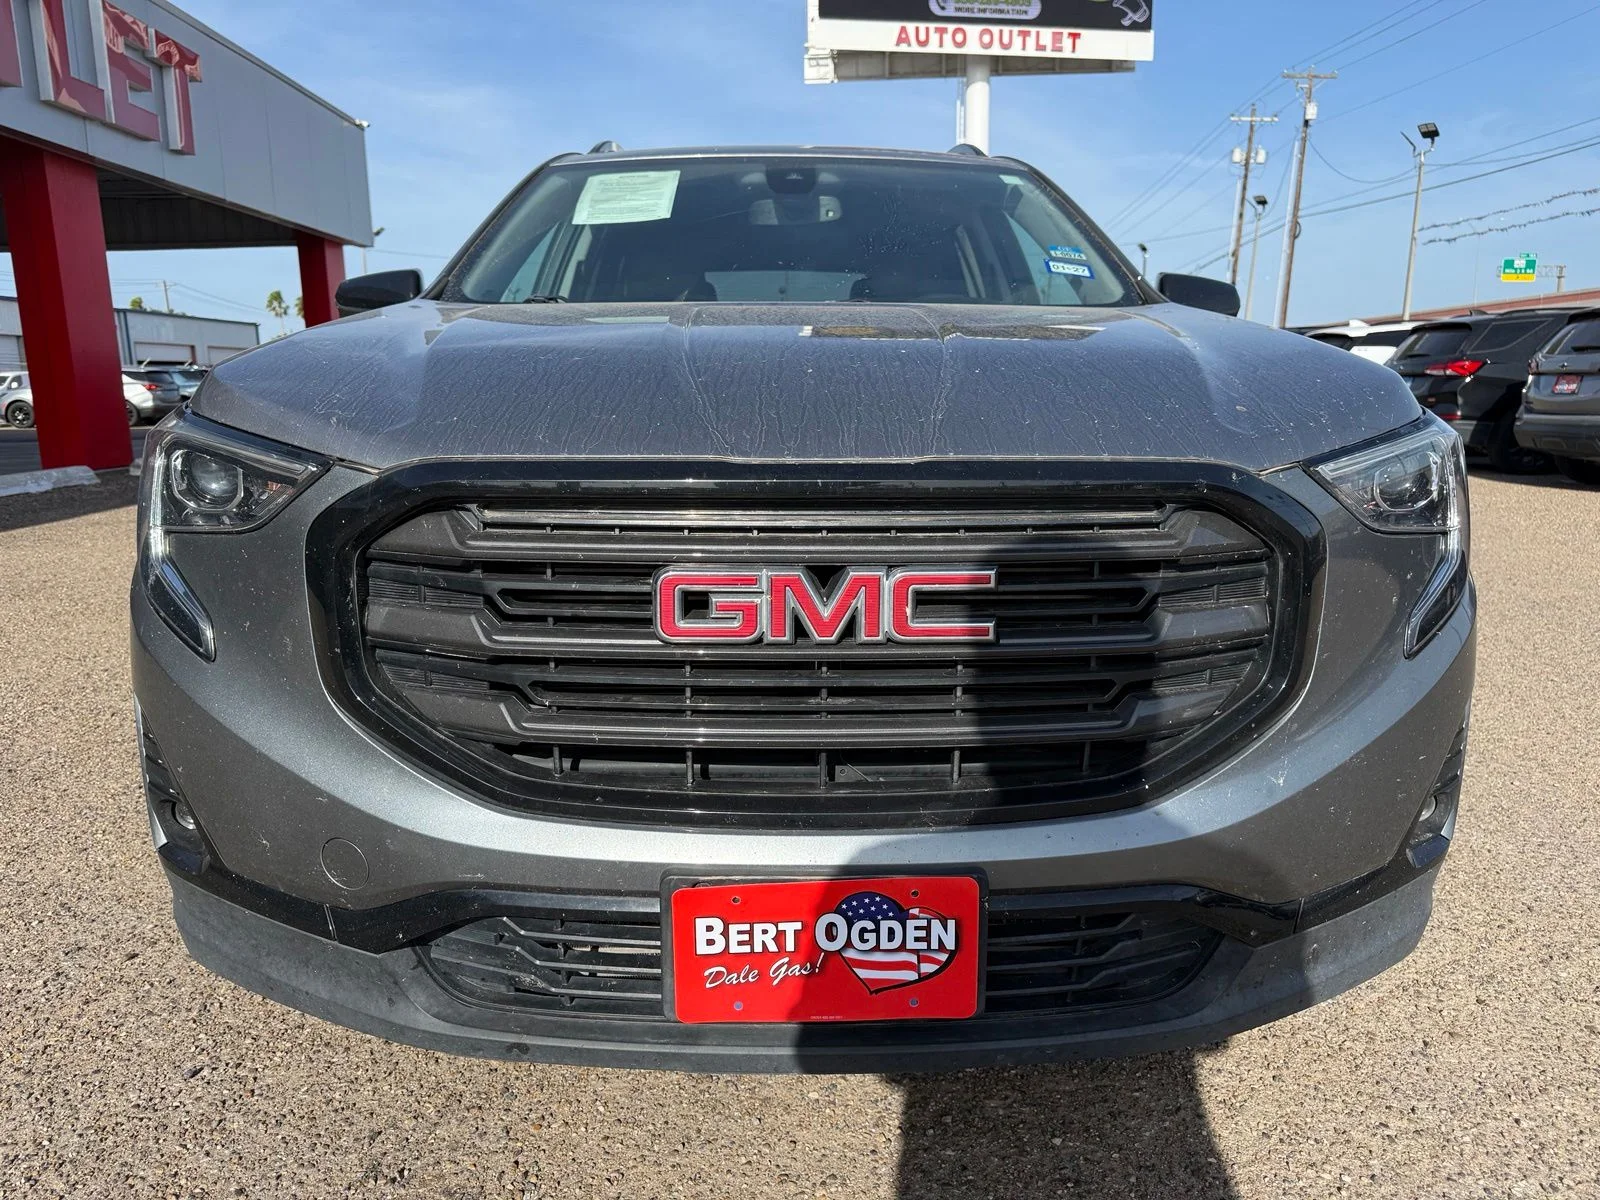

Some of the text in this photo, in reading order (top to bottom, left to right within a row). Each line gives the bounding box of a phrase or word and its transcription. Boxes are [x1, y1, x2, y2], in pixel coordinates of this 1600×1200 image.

[896, 25, 1082, 53] AUTO OUTLET
[654, 567, 997, 644] GMC
[693, 912, 957, 956] BERT OGDEN
[703, 951, 825, 989] Dale Gas!
